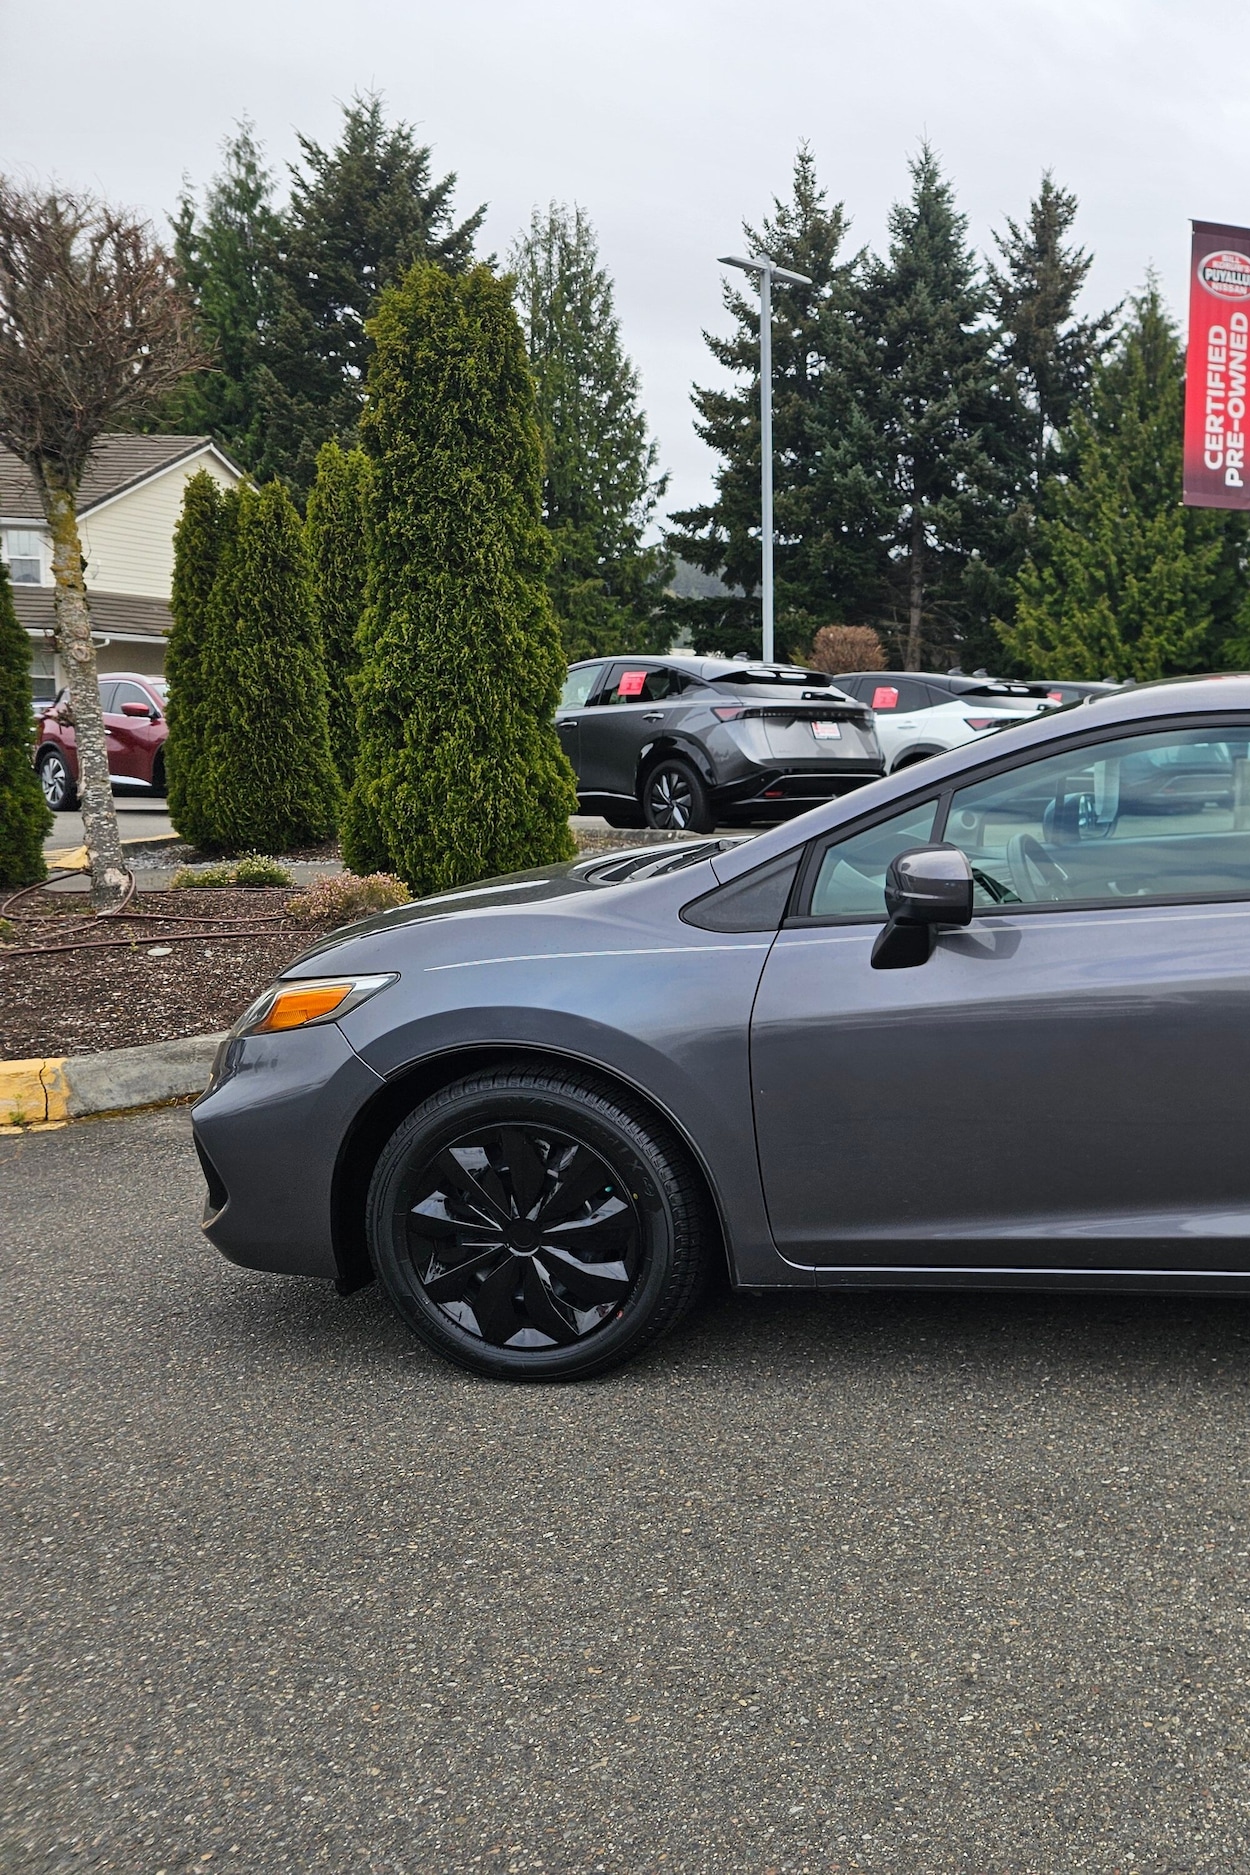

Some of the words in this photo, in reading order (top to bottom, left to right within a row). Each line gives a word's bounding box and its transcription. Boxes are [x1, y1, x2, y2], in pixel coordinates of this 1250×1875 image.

[1211, 281, 1248, 295] NISSAN
[1204, 325, 1227, 470] CERTIFIED
[1225, 312, 1248, 487] PRE-OWNED
